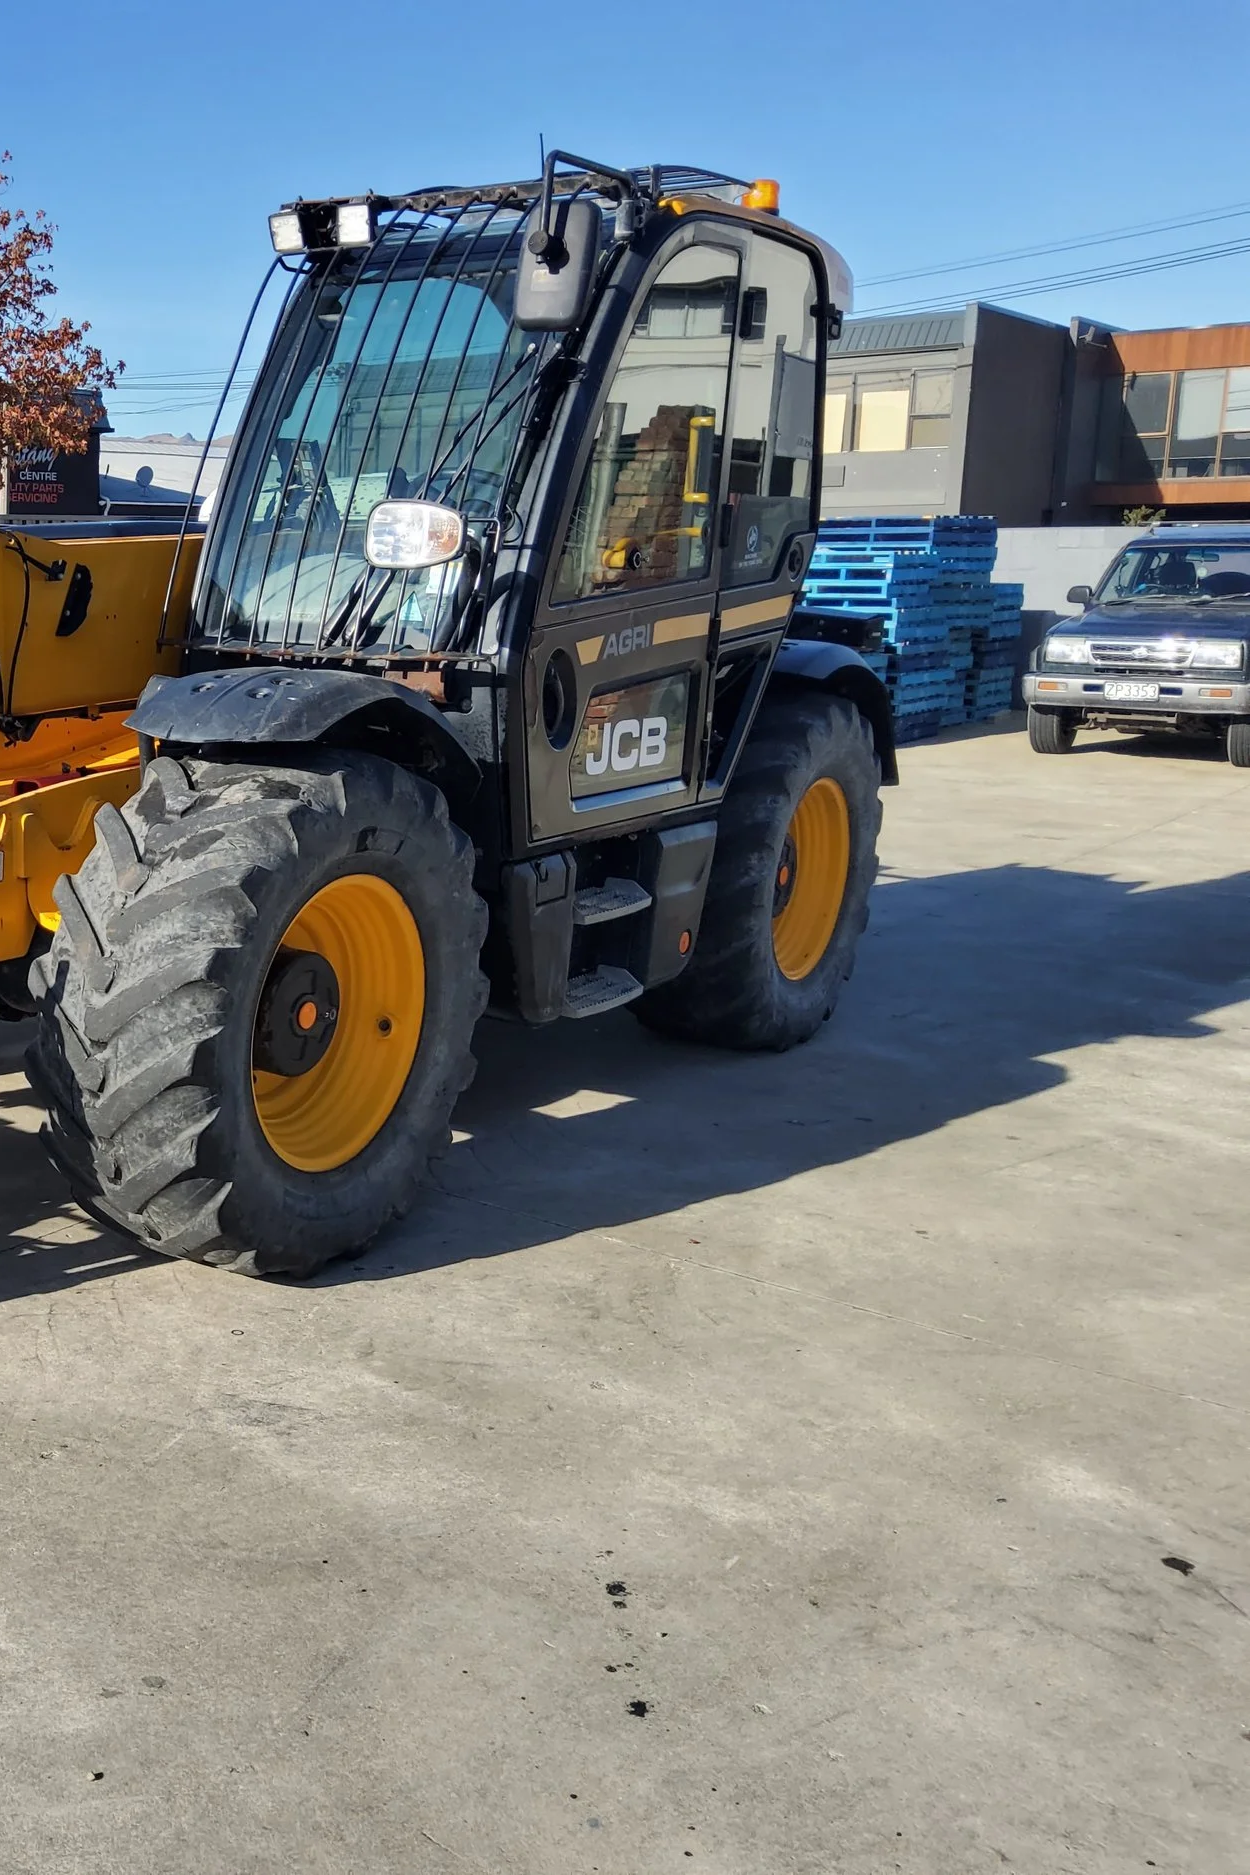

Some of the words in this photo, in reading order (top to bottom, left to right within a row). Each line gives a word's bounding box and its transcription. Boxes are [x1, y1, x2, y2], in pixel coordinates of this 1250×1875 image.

[19, 471, 57, 480] CENTRE
[10, 482, 30, 492] LITY
[32, 483, 64, 493] PARTS
[602, 623, 651, 660] AGRI
[1106, 684, 1157, 697] ZP3353
[585, 715, 668, 776] JCB
